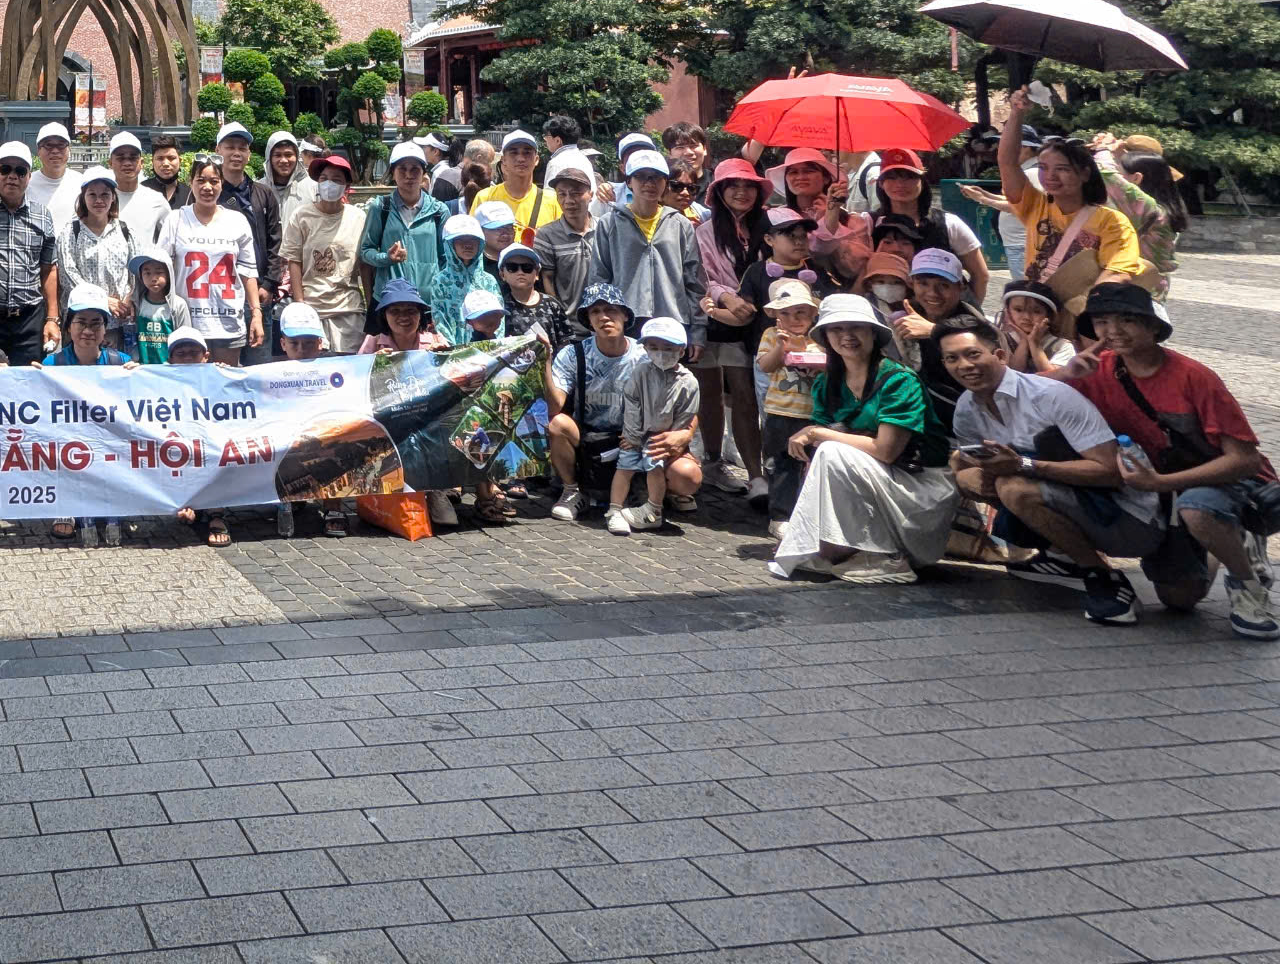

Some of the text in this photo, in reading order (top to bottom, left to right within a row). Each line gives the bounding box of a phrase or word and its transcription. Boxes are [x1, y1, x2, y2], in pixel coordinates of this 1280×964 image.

[187, 237, 236, 245] YOUTH
[185, 252, 236, 299] 24
[304, 378, 327, 387] TRAVEL
[51, 398, 118, 424] Filter
[126, 396, 182, 429] Việt
[191, 397, 257, 421] Nam
[129, 431, 205, 477] HỘI
[218, 435, 274, 468] AN
[8, 485, 57, 505] 2025
